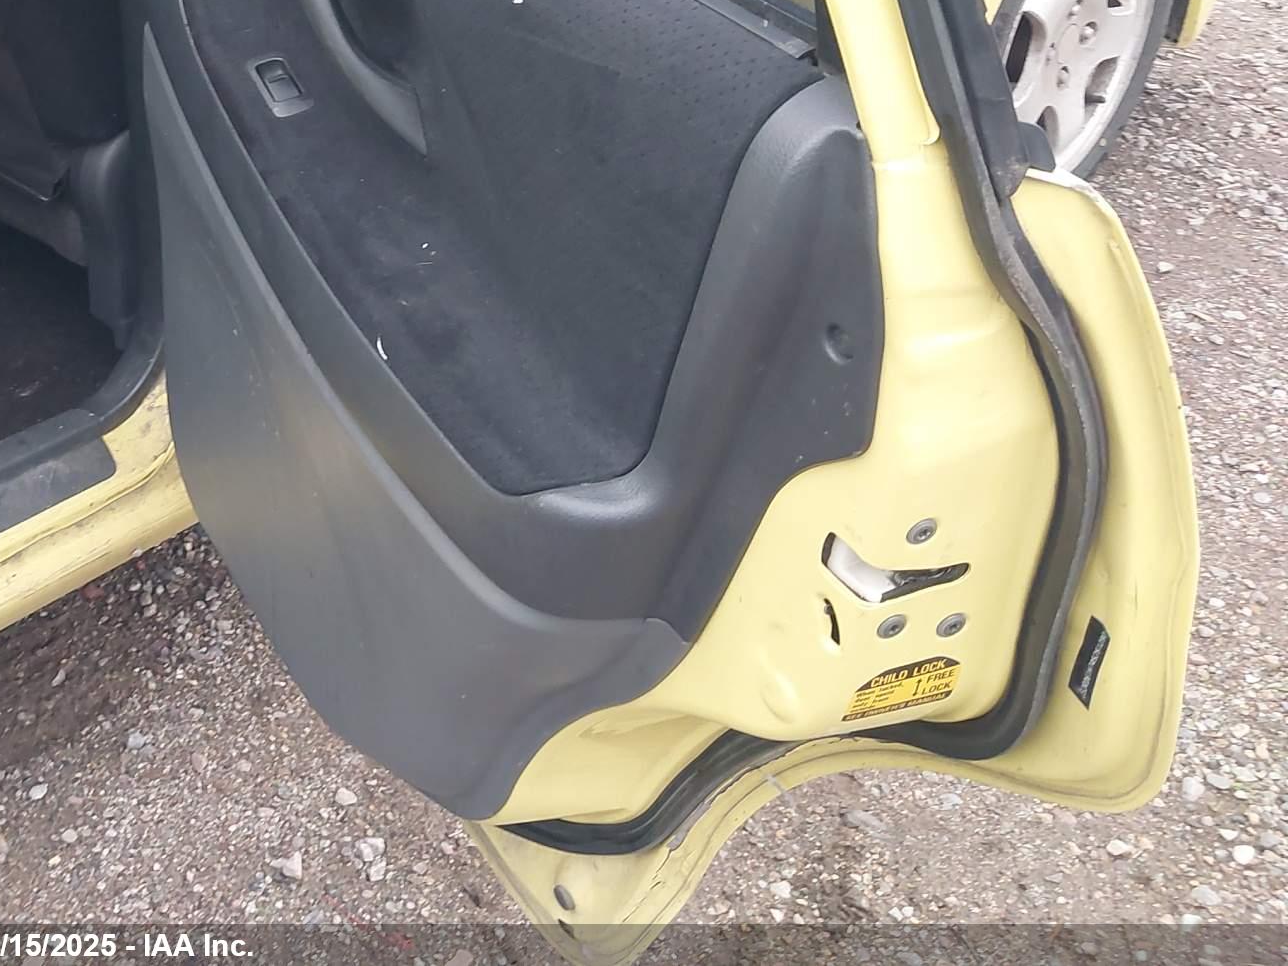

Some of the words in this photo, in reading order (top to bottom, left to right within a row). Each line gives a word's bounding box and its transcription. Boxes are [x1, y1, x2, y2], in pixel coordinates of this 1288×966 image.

[870, 669, 909, 688] CHILD
[913, 659, 948, 677] LOCK
[926, 669, 955, 684] FREE
[921, 680, 952, 695] LOCK
